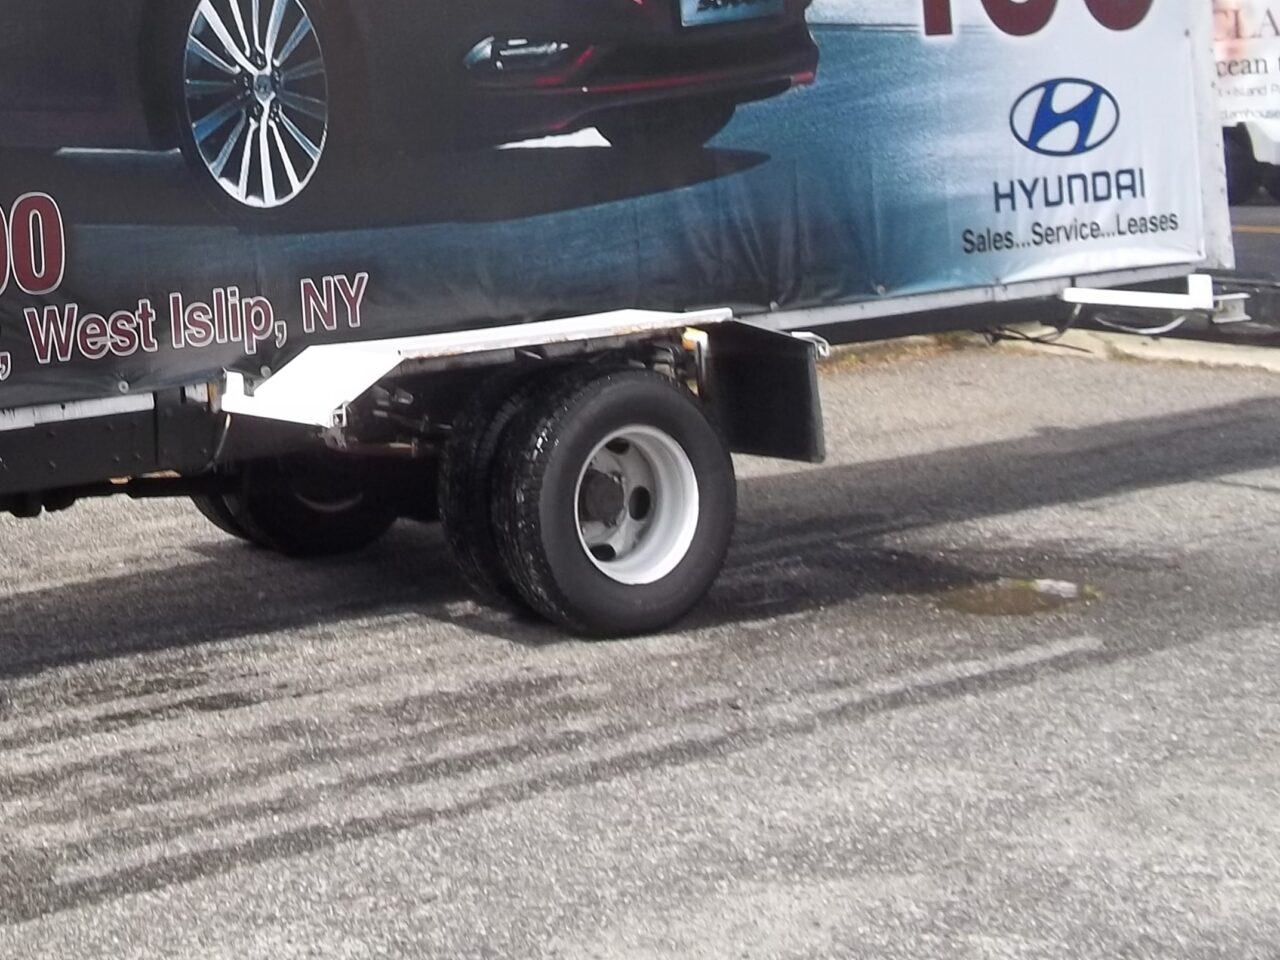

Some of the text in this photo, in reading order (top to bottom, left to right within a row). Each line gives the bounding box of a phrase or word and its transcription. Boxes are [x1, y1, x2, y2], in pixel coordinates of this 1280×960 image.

[993, 168, 1145, 213] HYUNDAI
[24, 298, 158, 363] West
[169, 286, 287, 355] Islip,
[300, 271, 369, 333] NY
